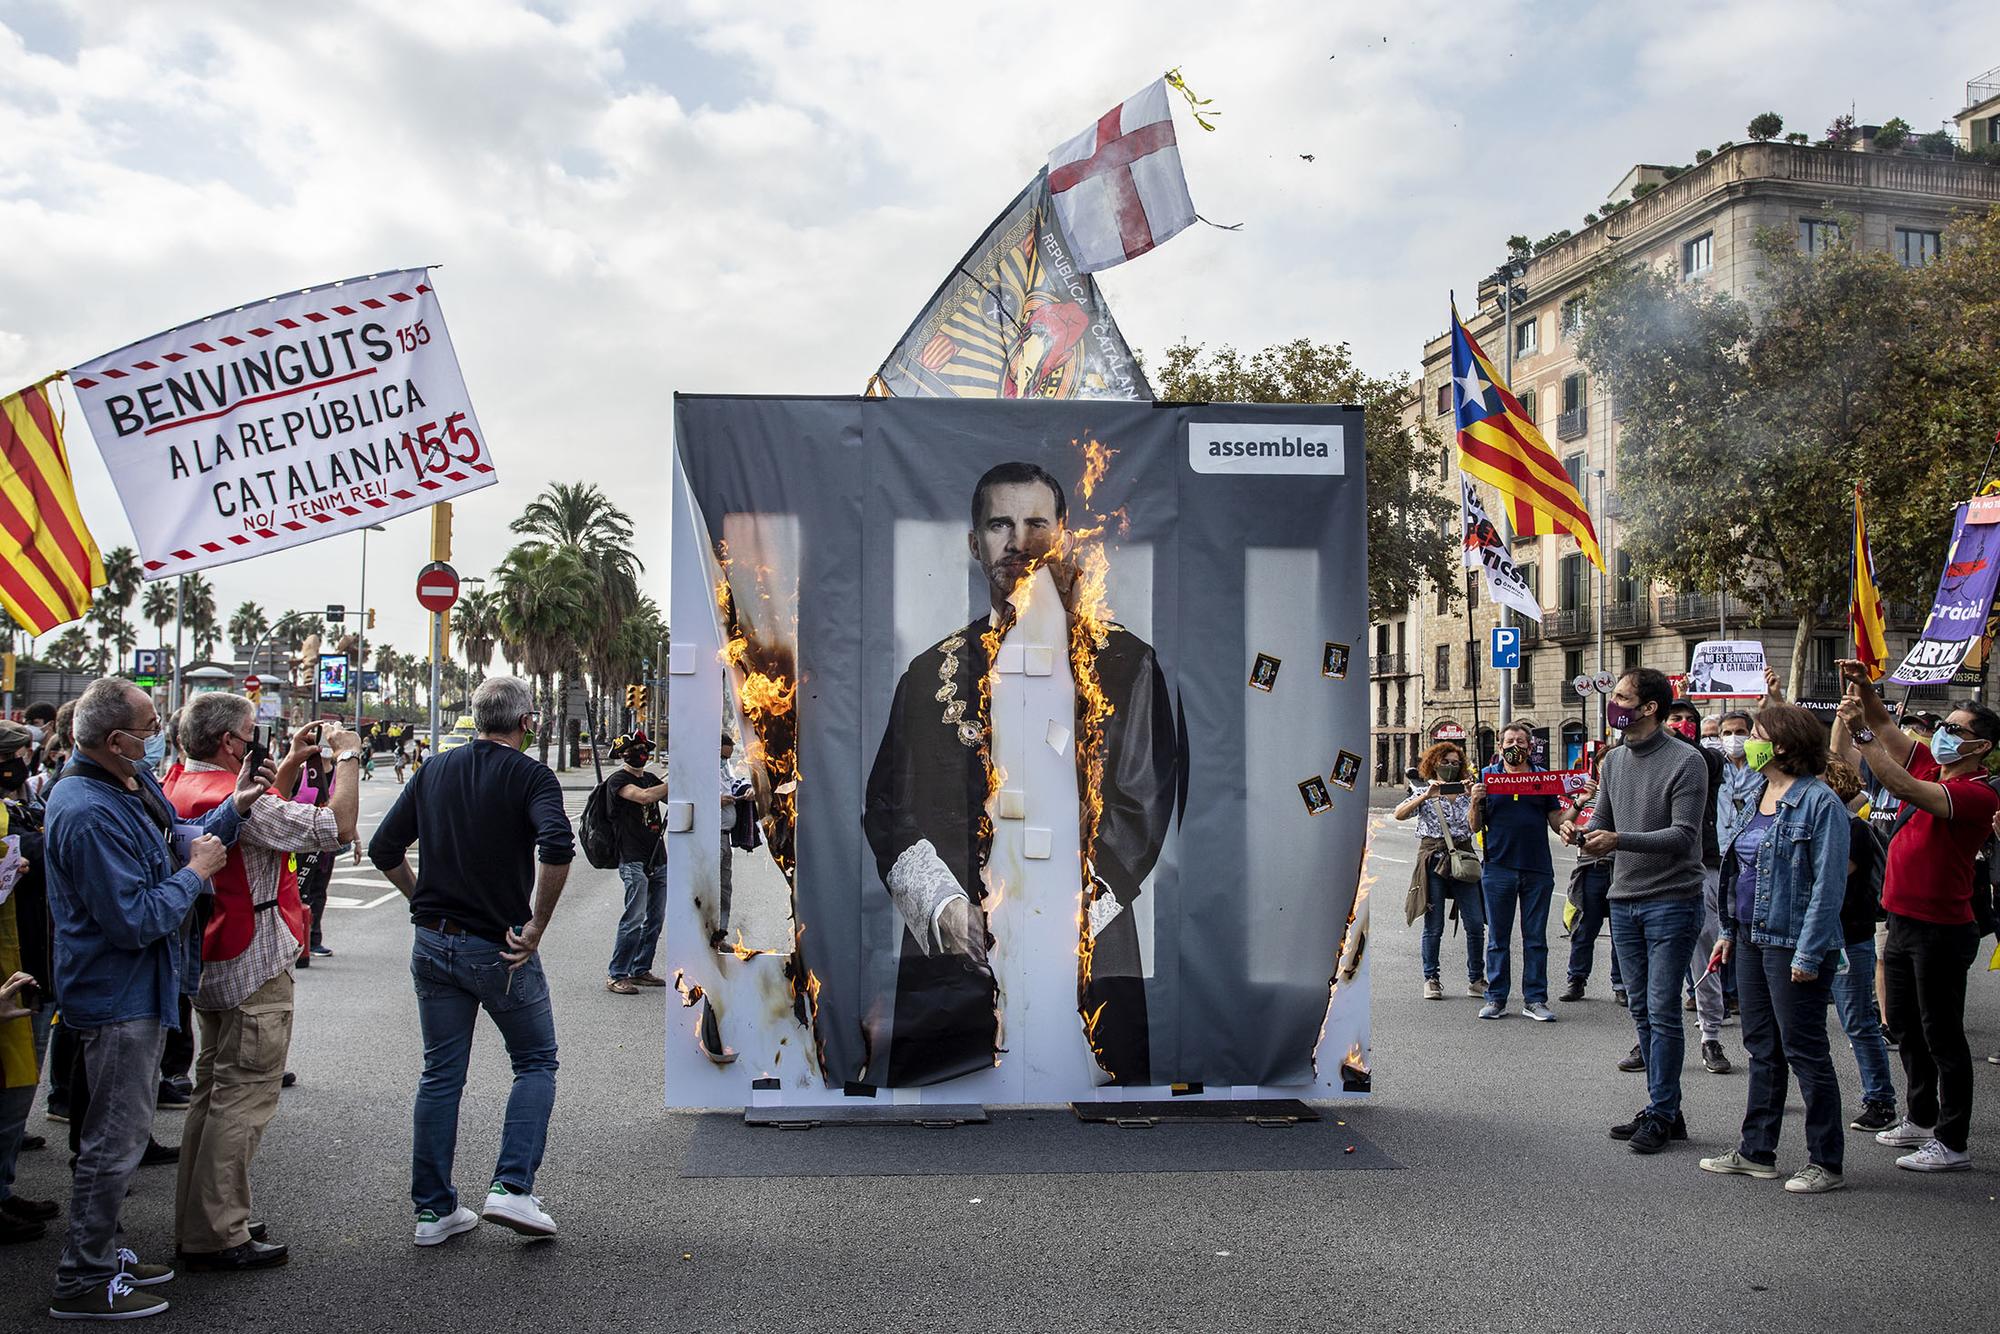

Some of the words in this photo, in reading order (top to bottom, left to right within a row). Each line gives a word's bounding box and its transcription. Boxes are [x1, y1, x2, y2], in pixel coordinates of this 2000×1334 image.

[1041, 232, 1087, 305] REPÚBLICA
[105, 322, 393, 437] BENVINGUTS
[396, 318, 431, 354] 155
[170, 445, 190, 479] A
[195, 433, 234, 474] LA
[239, 378, 426, 458] REPÚBLICA
[1208, 437, 1328, 458] assemblea
[212, 438, 403, 517] CATALANA
[400, 412, 480, 481] 155
[243, 510, 275, 532] NO!
[288, 492, 345, 521] TENIM
[351, 477, 387, 500] REI!
[1481, 547, 1526, 590] TICS.
[1497, 630, 1514, 652] P
[139, 651, 156, 673] P
[1705, 653, 1714, 663] NO
[1720, 663, 1725, 672] A
[1726, 663, 1763, 672] CATALUNYA
[1487, 775, 1540, 784] CATALUNYA
